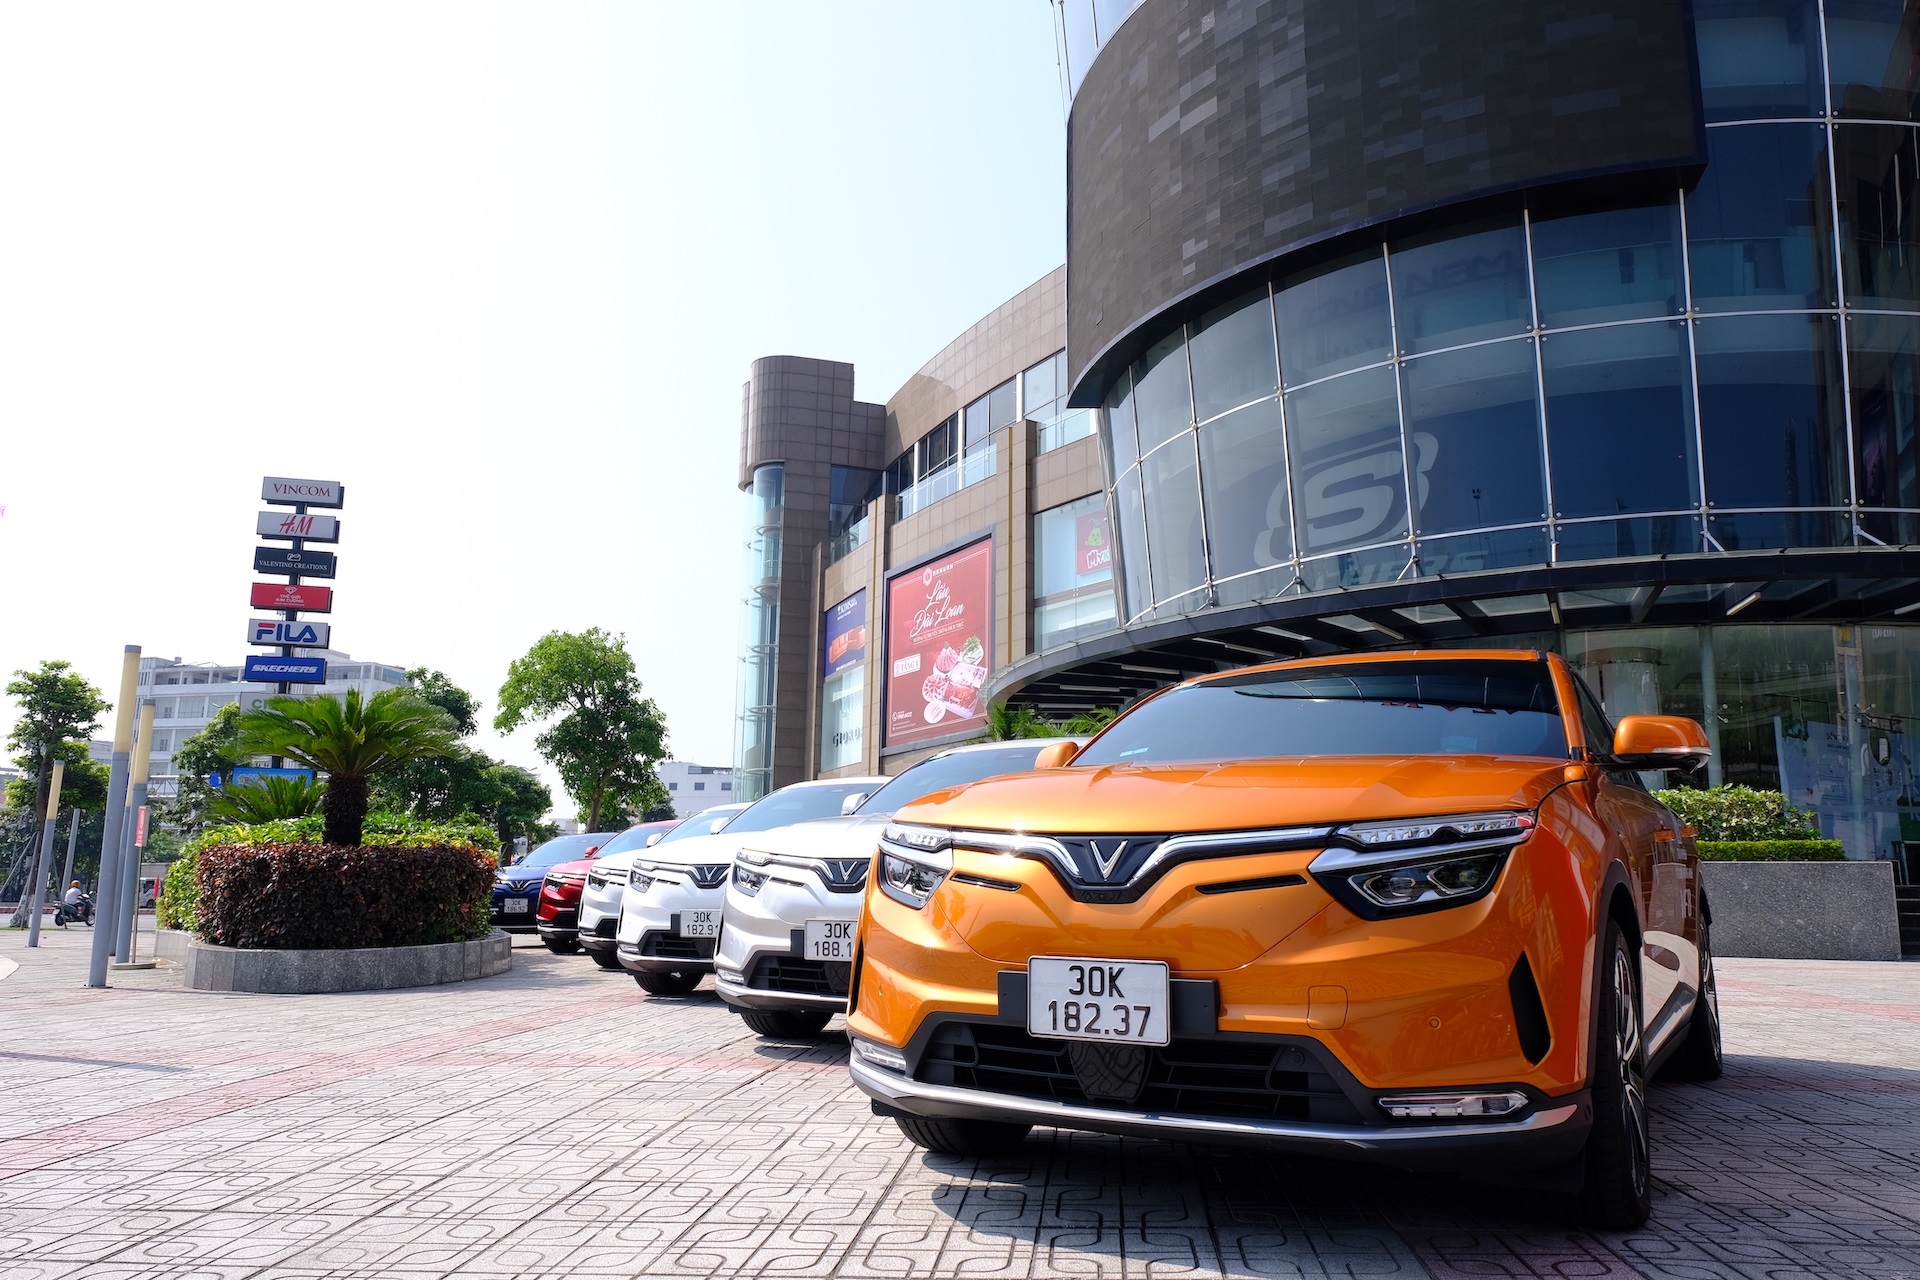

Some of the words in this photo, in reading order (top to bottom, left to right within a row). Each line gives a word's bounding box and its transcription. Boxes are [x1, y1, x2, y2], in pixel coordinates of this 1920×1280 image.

[273, 483, 331, 497] VINCOM
[279, 515, 314, 535] H&M
[258, 560, 293, 569] VALENTINO
[294, 562, 328, 571] CREATIONS
[910, 609, 934, 638] Đài
[934, 595, 965, 627] Loan
[256, 623, 318, 643] FILA
[252, 664, 318, 674] SKECHERS
[693, 912, 712, 923] 30K
[824, 923, 851, 939] 30K
[814, 941, 852, 958] 188.1
[1068, 965, 1125, 998] 30K
[1048, 1000, 1151, 1037] 182.37
